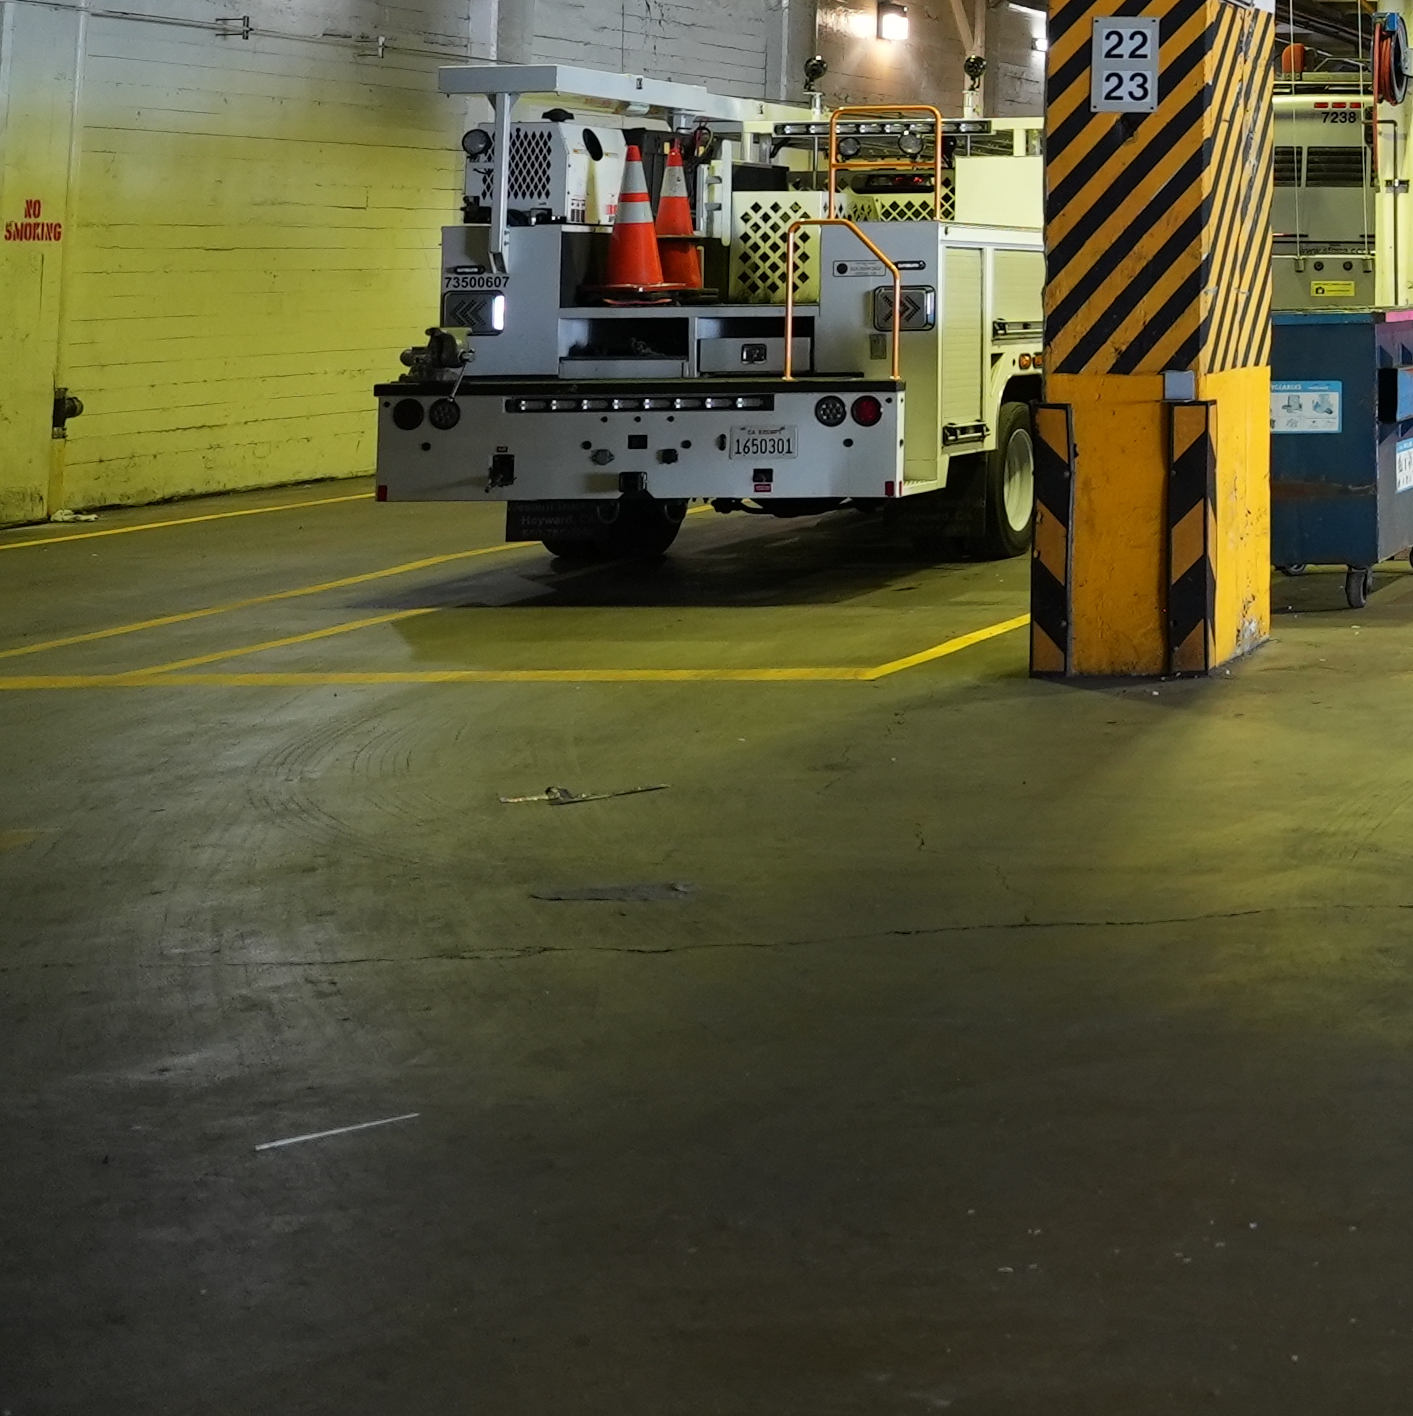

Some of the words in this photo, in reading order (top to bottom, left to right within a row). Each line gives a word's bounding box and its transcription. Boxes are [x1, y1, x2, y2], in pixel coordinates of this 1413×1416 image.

[1104, 30, 1148, 59] 22
[1104, 72, 1149, 101] 23
[1321, 111, 1357, 124] 7238
[24, 199, 42, 219] NO
[4, 221, 62, 241] SMOKING
[444, 276, 510, 289] 73500607
[735, 438, 793, 454] 1650301
